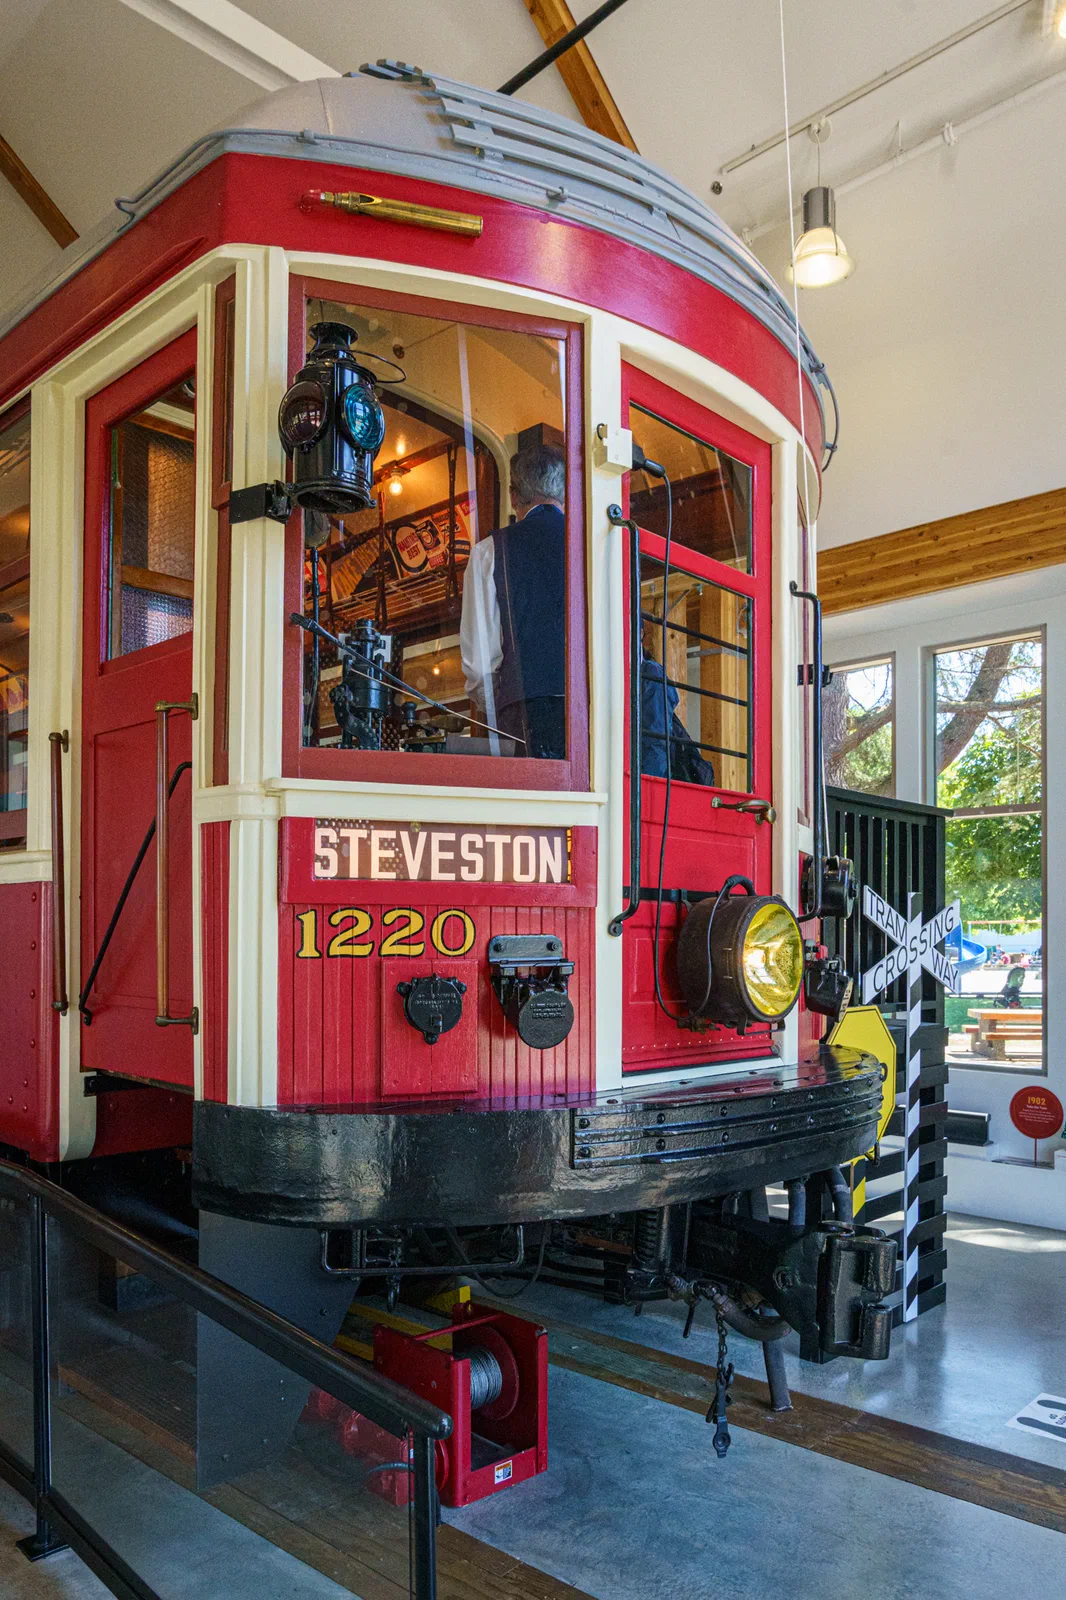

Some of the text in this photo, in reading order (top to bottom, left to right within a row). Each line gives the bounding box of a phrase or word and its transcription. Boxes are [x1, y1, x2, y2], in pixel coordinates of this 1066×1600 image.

[406, 544, 421, 560] BEST
[314, 827, 562, 883] STEVESTON
[296, 907, 476, 958] 1220
[867, 888, 958, 990] TRAM WAY
[873, 906, 954, 993] CROSSING
[1027, 1096, 1046, 1105] 1902
